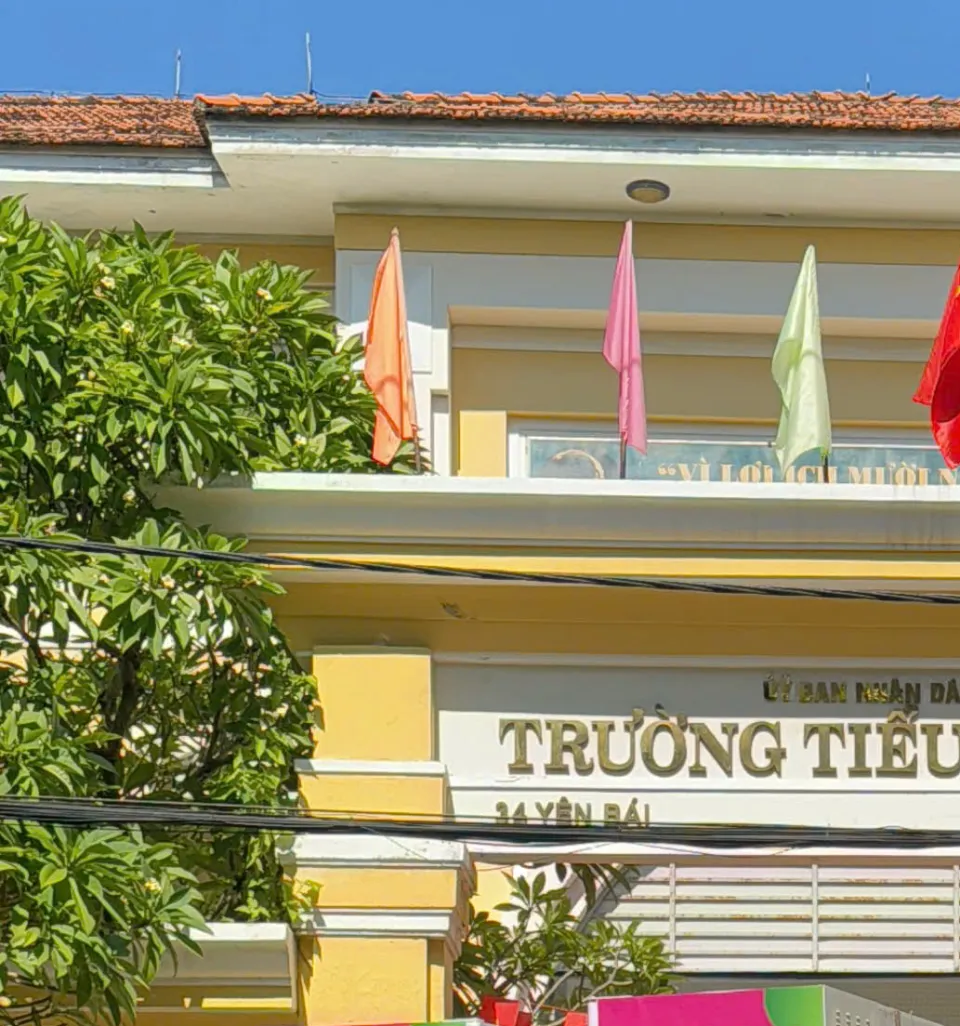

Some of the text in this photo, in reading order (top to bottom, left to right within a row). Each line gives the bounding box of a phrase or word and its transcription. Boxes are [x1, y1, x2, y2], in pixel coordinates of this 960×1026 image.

[799, 681, 847, 704] BAN
[855, 678, 921, 704] NHÂN
[499, 703, 788, 779] TRƯỜNG
[534, 795, 592, 827] YÊN
[603, 797, 650, 828] BÁI
